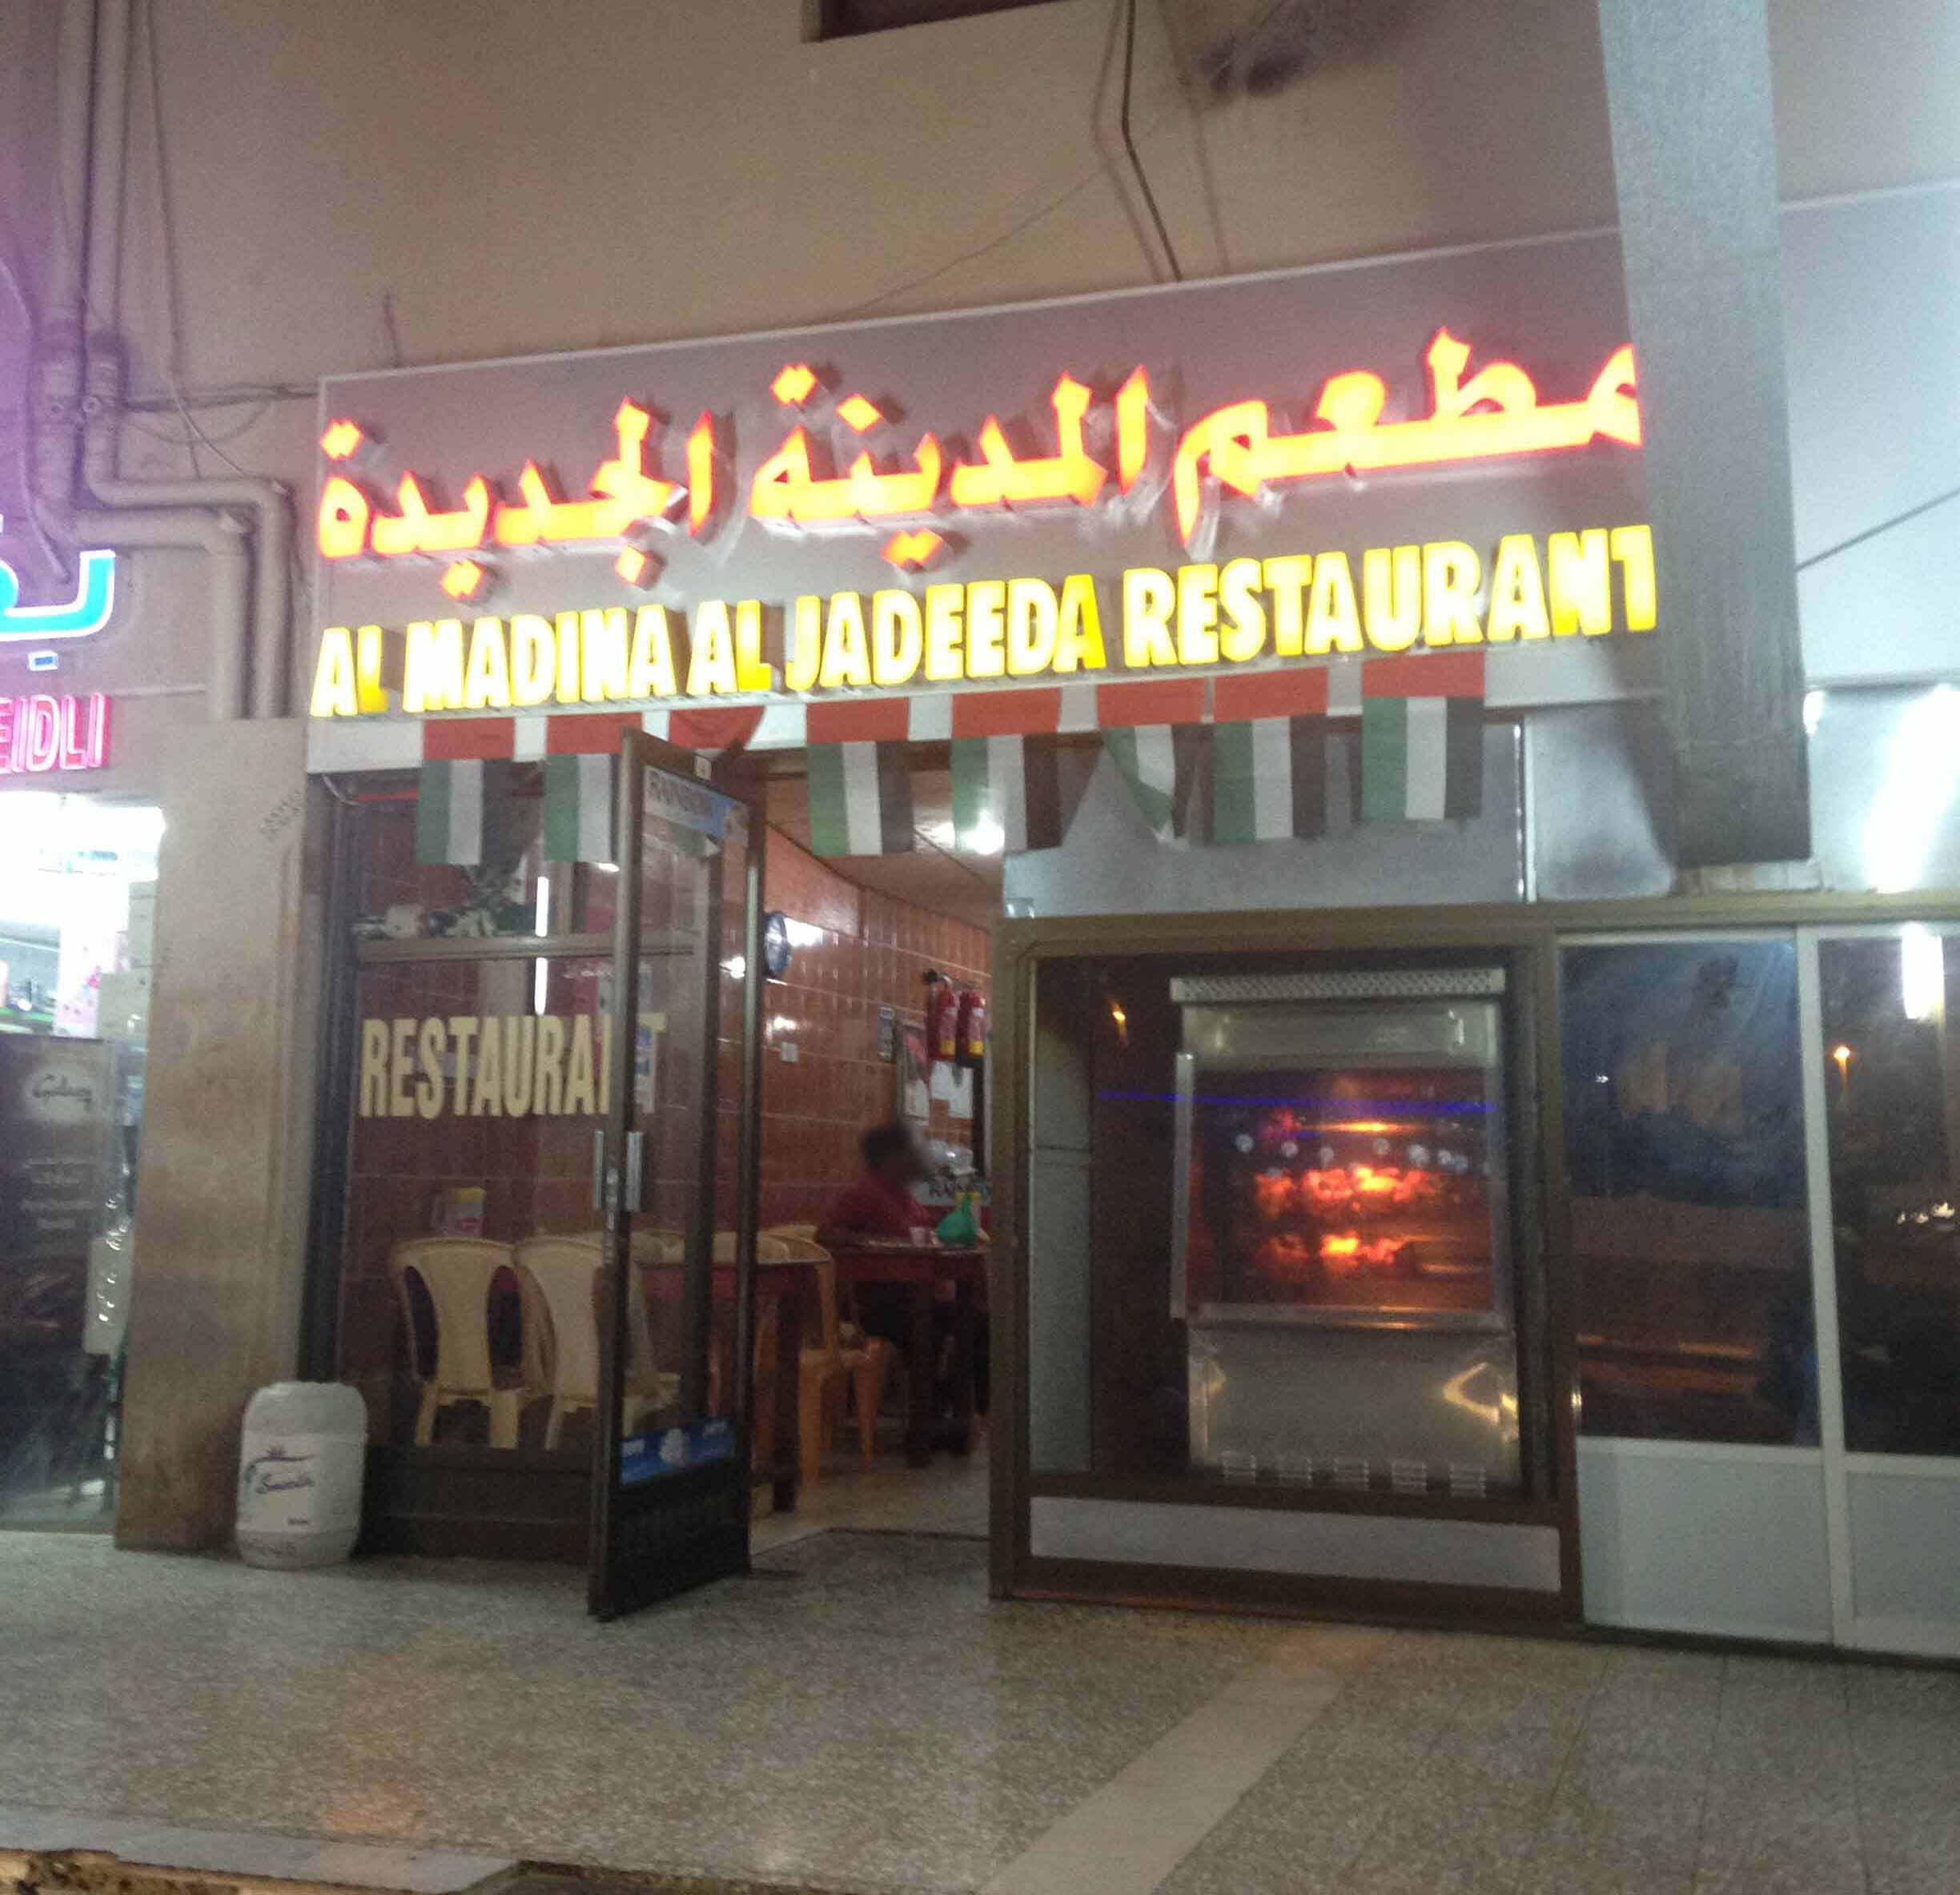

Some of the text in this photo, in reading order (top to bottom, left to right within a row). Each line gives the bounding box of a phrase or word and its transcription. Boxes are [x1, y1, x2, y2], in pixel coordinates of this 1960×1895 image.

[315, 325, 1644, 601] مطعم المدينة الجديدة
[309, 524, 1657, 718] AL MADINA AL JADEEDA RESTAURANT
